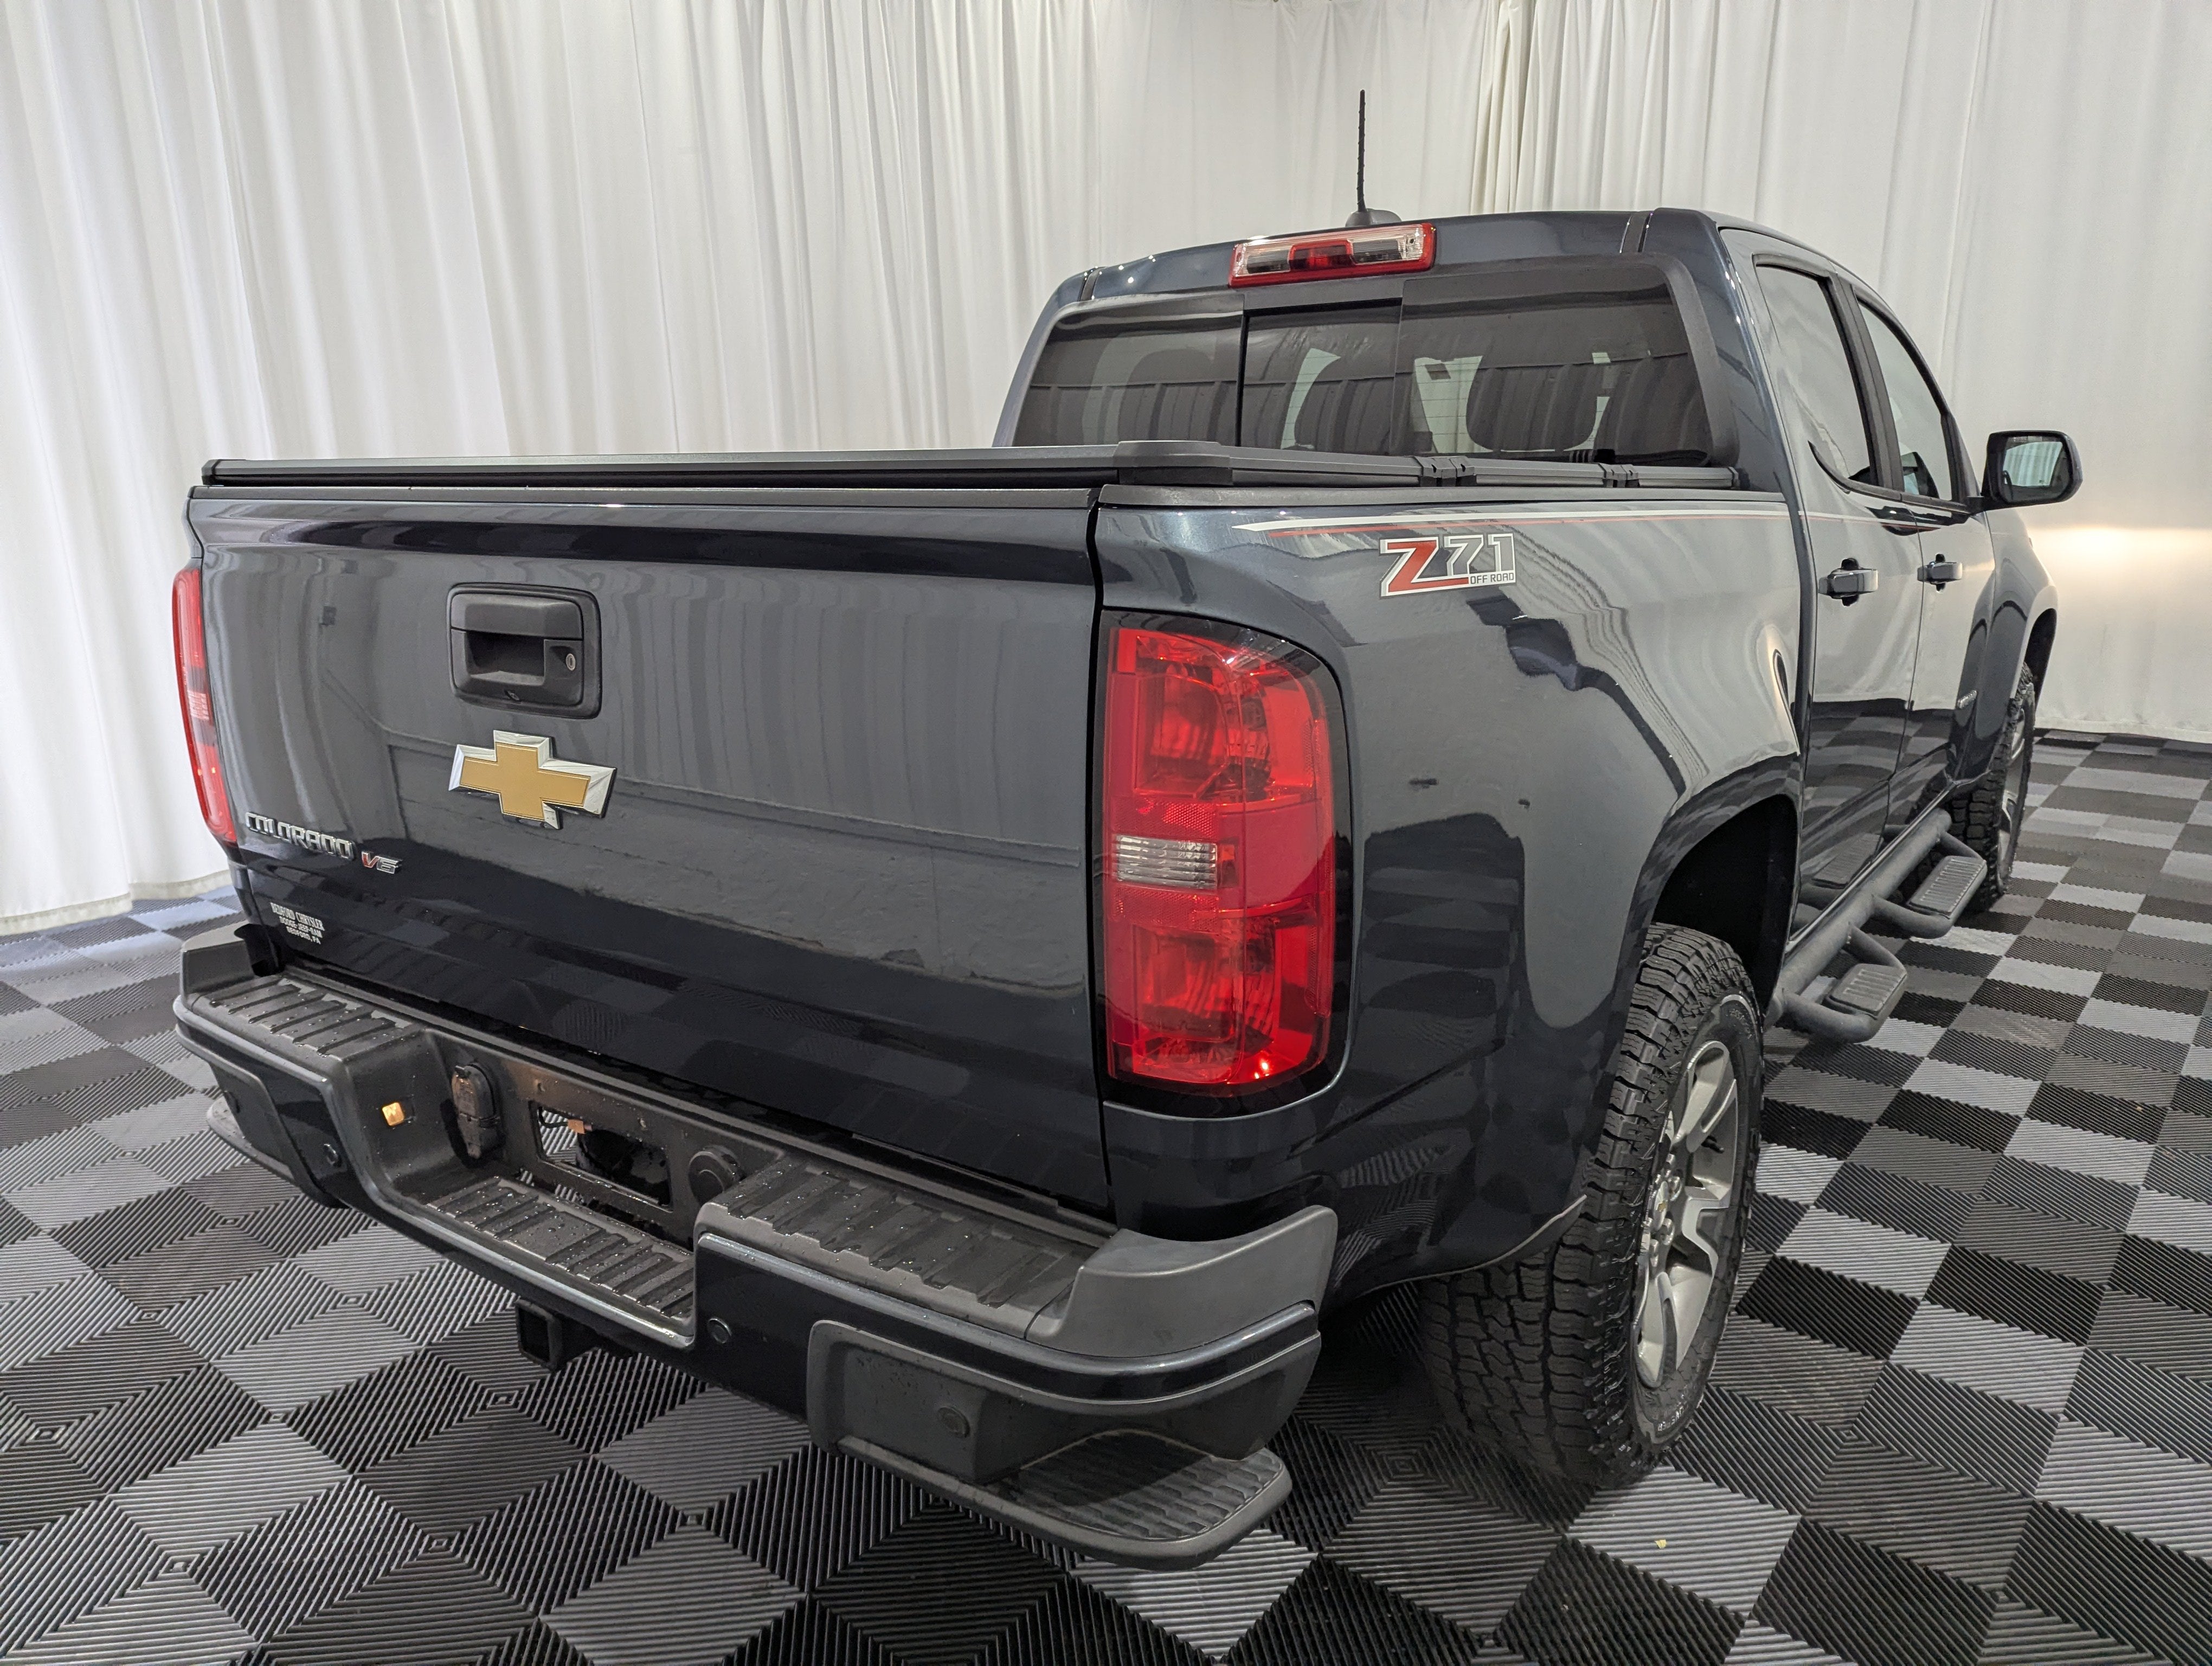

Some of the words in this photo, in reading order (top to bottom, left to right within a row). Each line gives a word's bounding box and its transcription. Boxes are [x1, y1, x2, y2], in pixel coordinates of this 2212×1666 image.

[1380, 533, 1516, 597] Z71
[1470, 575, 1488, 585] OFF
[1490, 572, 1514, 582] ROAD
[246, 812, 355, 859] COLORADO
[361, 851, 402, 874] V6
[295, 912, 325, 931] CHRYSLER
